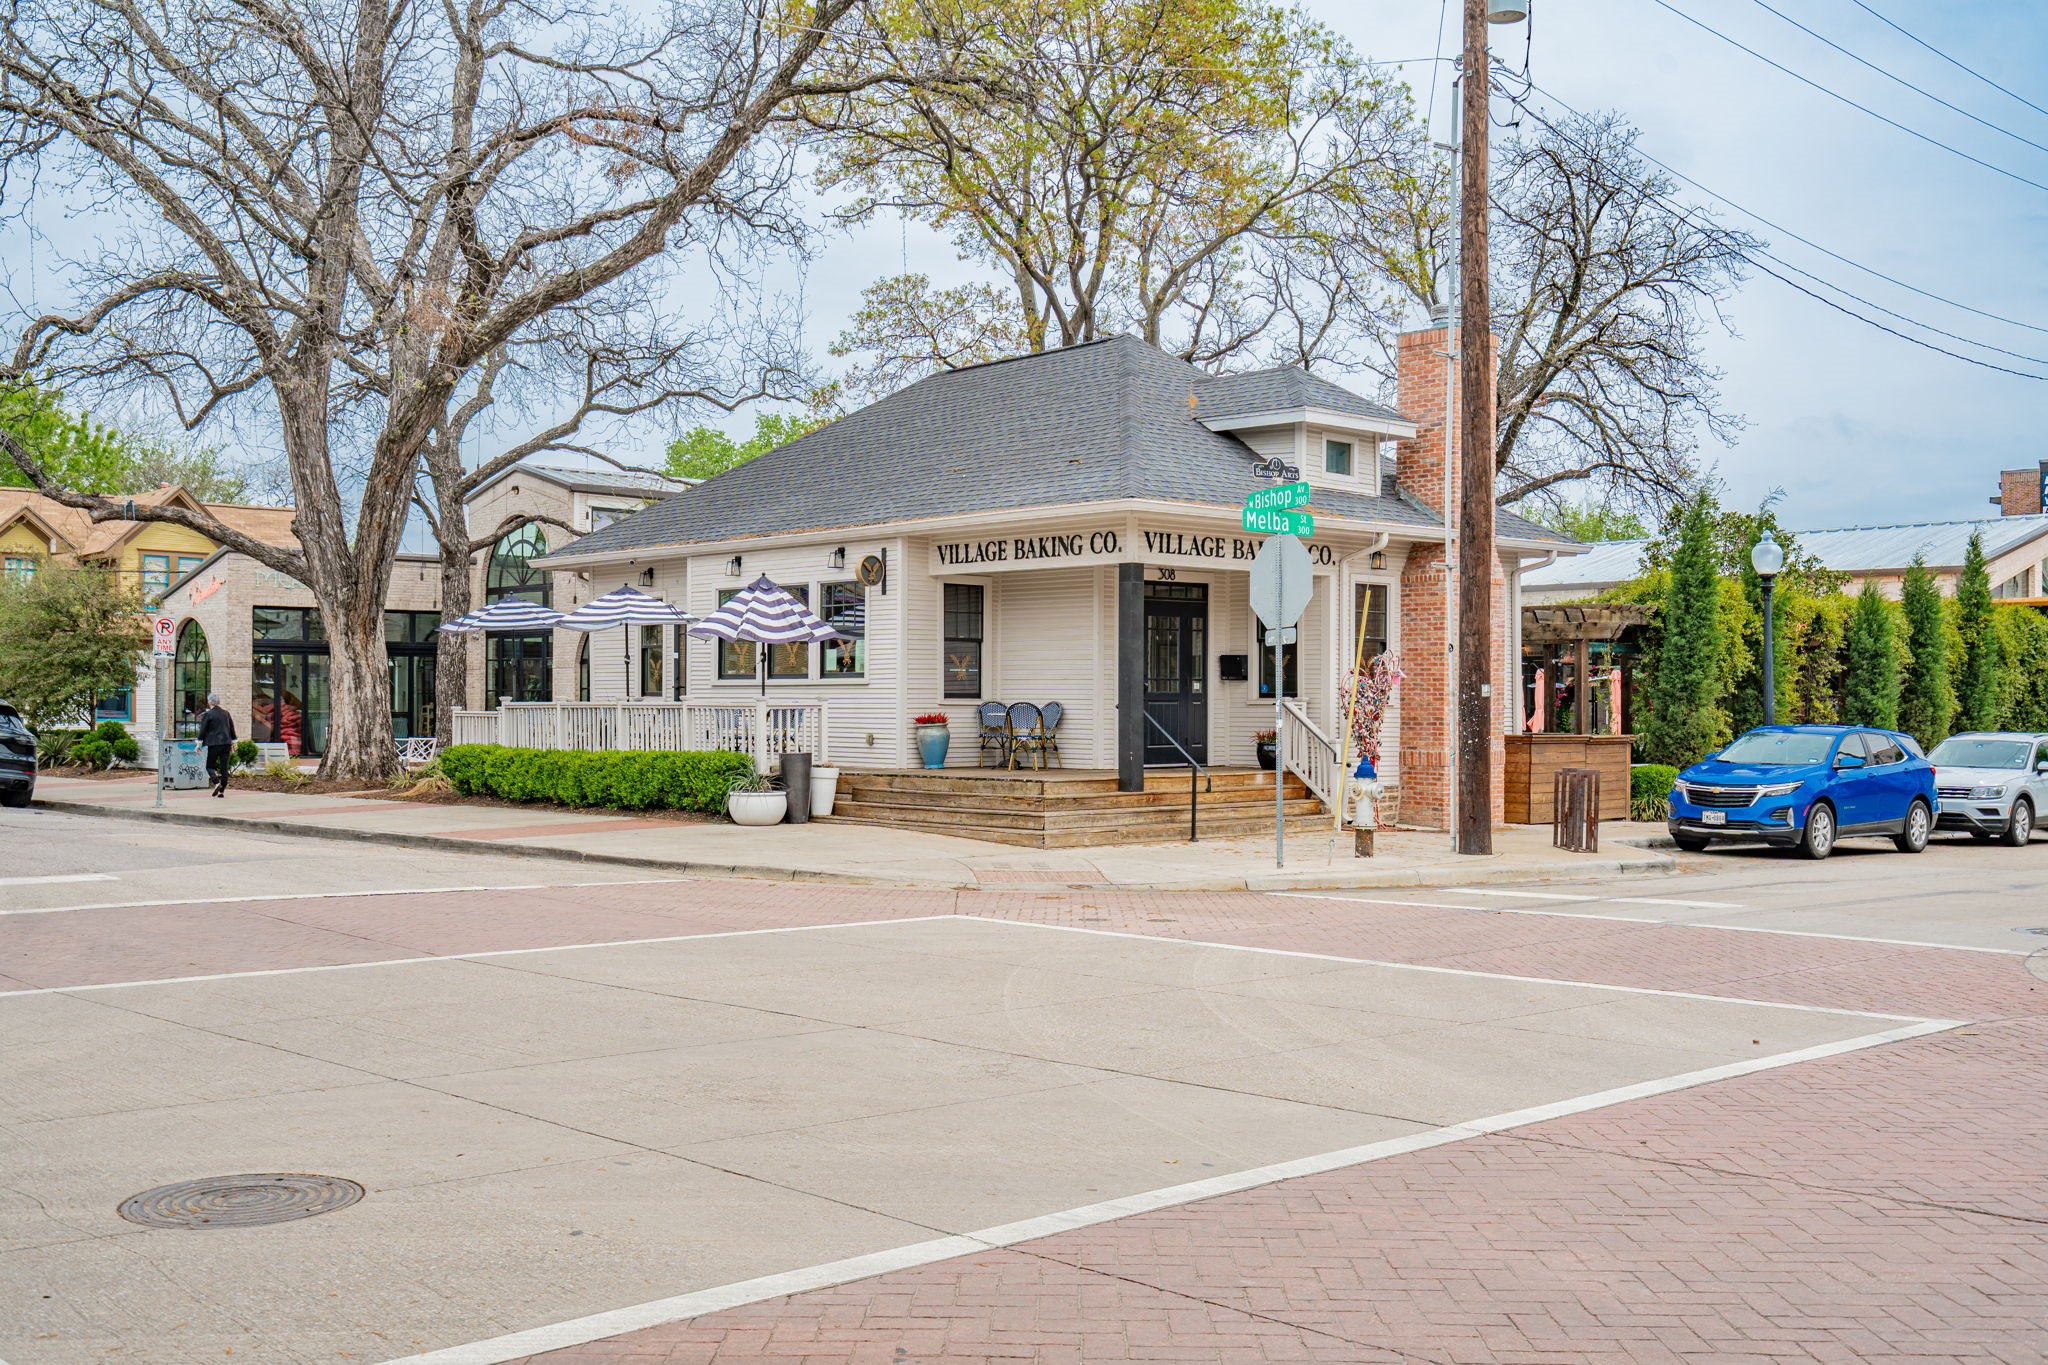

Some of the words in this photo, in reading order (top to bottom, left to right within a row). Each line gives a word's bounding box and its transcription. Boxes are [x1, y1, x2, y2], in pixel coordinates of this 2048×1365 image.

[1255, 489, 1292, 509] Bishop
[1295, 495, 1308, 506] 300
[1246, 510, 1289, 532] Melba
[1300, 514, 1307, 524] St
[1298, 525, 1310, 535] 300
[937, 540, 1008, 565] VILLAGE
[1014, 534, 1083, 560] BAKING
[1089, 531, 1122, 554] CO.
[1143, 531, 1226, 558] VILLAGE
[1157, 567, 1176, 581] 308
